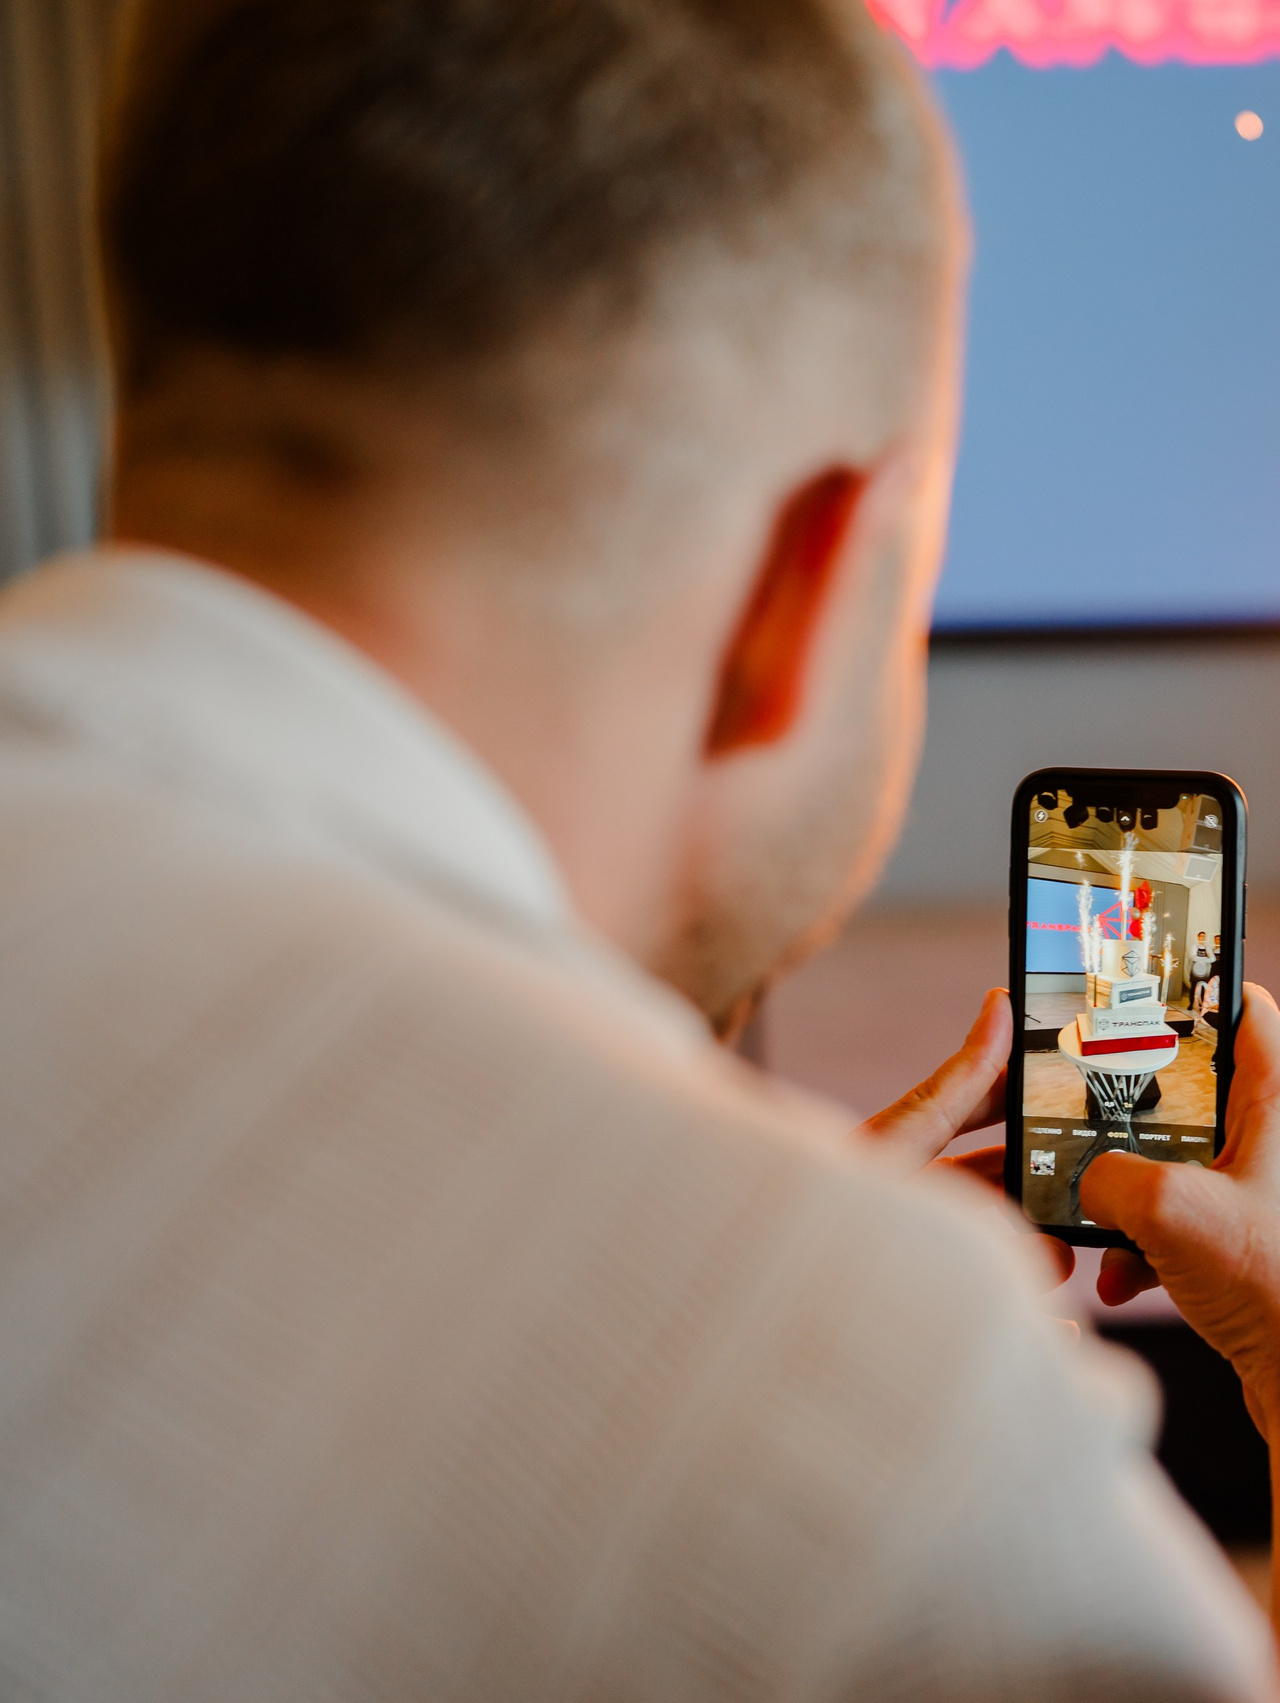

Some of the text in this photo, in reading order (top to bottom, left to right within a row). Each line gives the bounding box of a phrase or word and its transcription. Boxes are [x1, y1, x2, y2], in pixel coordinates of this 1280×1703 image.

[1112, 1020, 1161, 1028] ТРАНСПАК
[1072, 1129, 1097, 1137] ВИДЕО
[1107, 1131, 1129, 1139] ФОТО
[1139, 1133, 1171, 1141] ПОРТРЕТ
